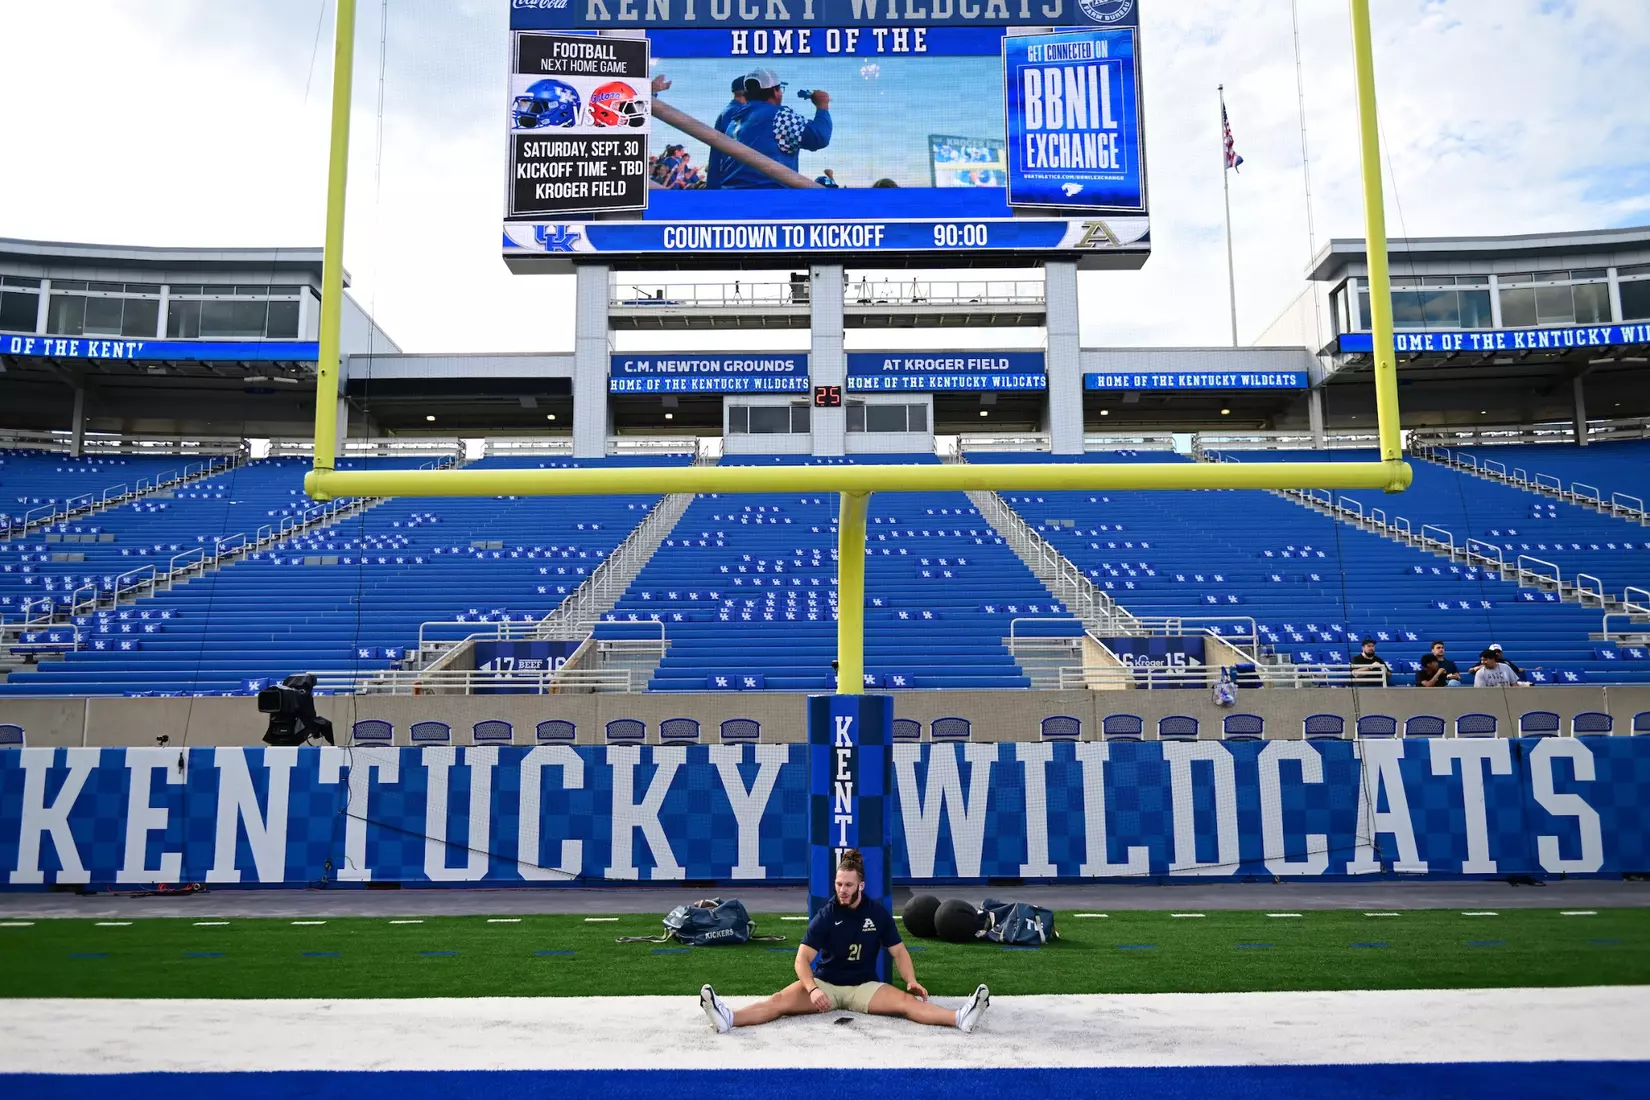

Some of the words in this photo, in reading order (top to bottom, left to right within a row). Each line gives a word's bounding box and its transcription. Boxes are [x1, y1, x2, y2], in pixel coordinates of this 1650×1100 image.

[1104, 2, 1130, 20] BUREAU
[731, 29, 811, 54] HOME
[826, 28, 860, 53] OF
[873, 28, 928, 52] THE
[553, 42, 617, 60] FOOTBALL
[1027, 45, 1042, 62] GET
[1046, 42, 1092, 60] CONNECTED
[1095, 40, 1108, 58] ON
[541, 58, 568, 71] NEXT
[570, 60, 598, 72] HOME
[600, 61, 628, 74] GAME
[1024, 64, 1118, 130] BBNIL
[524, 142, 588, 158] SATURDAY,
[591, 141, 622, 156] SEPT.
[624, 140, 639, 156] 30
[1026, 132, 1120, 169] EXCHANGE
[517, 162, 574, 179] KICKOFF
[576, 162, 608, 177] TIME
[620, 160, 644, 176] TBD
[535, 182, 588, 200] KROGER
[592, 181, 626, 196] FIELD
[664, 226, 780, 250] COUNTDOWN
[782, 225, 804, 248] TO
[809, 224, 885, 248] KICKOFF
[933, 224, 988, 246] 90:00
[10, 337, 35, 354] OF
[44, 338, 78, 356] THE
[1393, 334, 1433, 350] OME
[1442, 333, 1462, 350] OF
[1470, 332, 1505, 350] THE
[1514, 327, 1612, 348] KENTUCKY
[624, 360, 654, 373] C.M.
[656, 360, 720, 372] NEWTON
[724, 360, 794, 372] GROUNDS
[883, 359, 901, 370] AT
[904, 358, 964, 370] KROGER
[968, 358, 1009, 370] FIELD
[610, 379, 642, 390] HOME
[646, 379, 661, 390] OF
[665, 378, 687, 390] THE
[691, 378, 750, 389] KENTUCKY
[754, 378, 809, 389] WILDCATS
[848, 378, 880, 389] HOME
[884, 377, 898, 389] OF
[902, 377, 925, 388] THE
[929, 376, 988, 388] KENTUCKY
[992, 376, 1047, 388] WILDCATS
[1098, 376, 1130, 387] HOME
[1134, 375, 1148, 387] OF
[1152, 375, 1174, 386] THE
[1178, 374, 1236, 386] KENTUCKY
[1240, 374, 1297, 386] WILDCATS
[816, 388, 840, 404] 25
[494, 656, 514, 678] 17
[1134, 655, 1164, 672] Kroger
[1165, 652, 1186, 674] 15
[9, 744, 790, 884] KENTUCKY
[893, 737, 1605, 878] WILDCATS
[704, 928, 734, 940] KICKERS
[848, 944, 862, 961] 21
